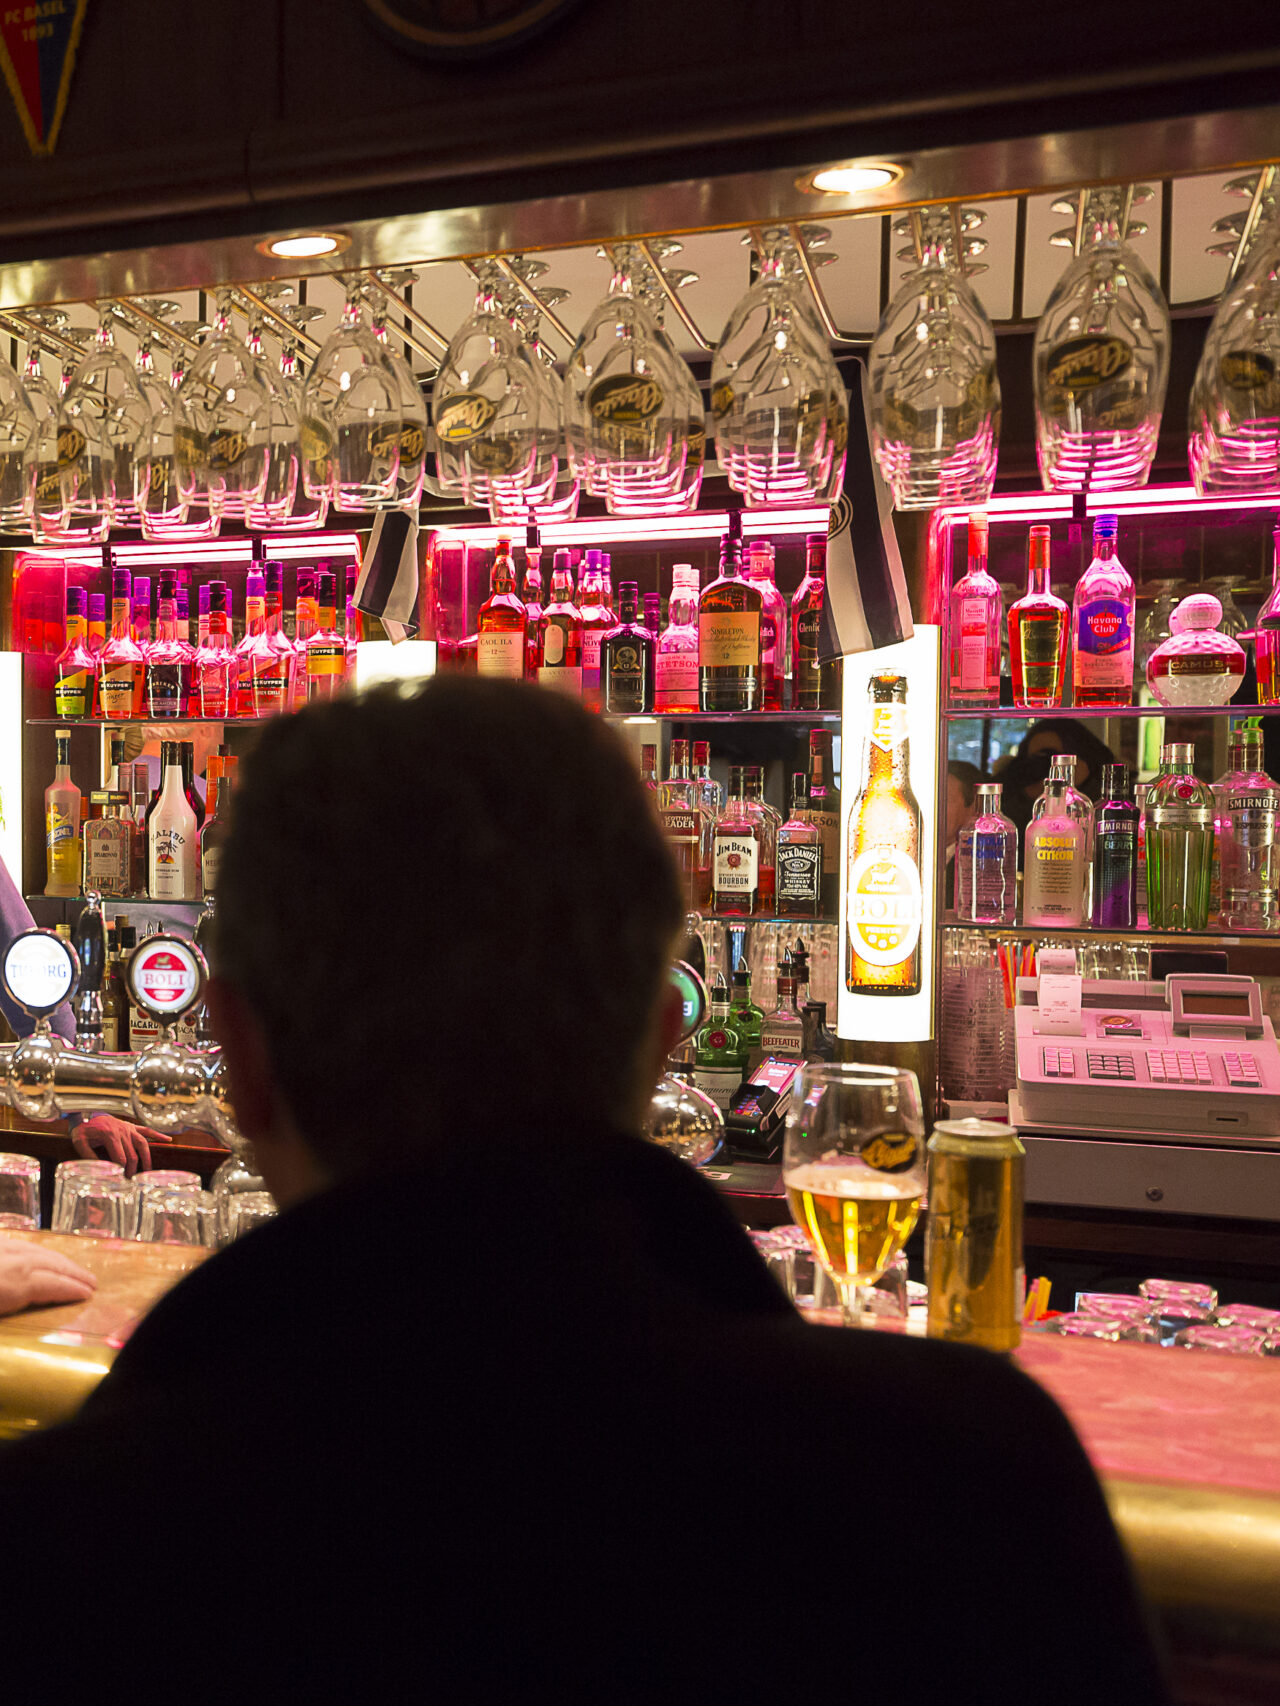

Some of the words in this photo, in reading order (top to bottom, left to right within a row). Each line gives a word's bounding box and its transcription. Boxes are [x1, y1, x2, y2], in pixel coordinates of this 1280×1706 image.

[593, 381, 661, 418] Classic
[1087, 615, 1122, 625] Havana
[710, 627, 745, 635] SINGLETON
[1094, 625, 1115, 633] Club
[656, 660, 699, 670] STETSON
[1171, 660, 1224, 669] CAMUS
[1228, 798, 1279, 809] SMIRNOFF
[1034, 837, 1078, 847] ABSOLUT
[717, 844, 730, 857] JIM
[731, 841, 752, 857] BEAM
[778, 849, 794, 862] JACK
[1036, 850, 1074, 860] CITRON
[718, 877, 749, 885] BOURBON
[10, 963, 67, 978] TURG
[144, 973, 184, 985] BOLI
[130, 1019, 160, 1029] BACARD
[762, 1037, 800, 1048] BEEFEATER
